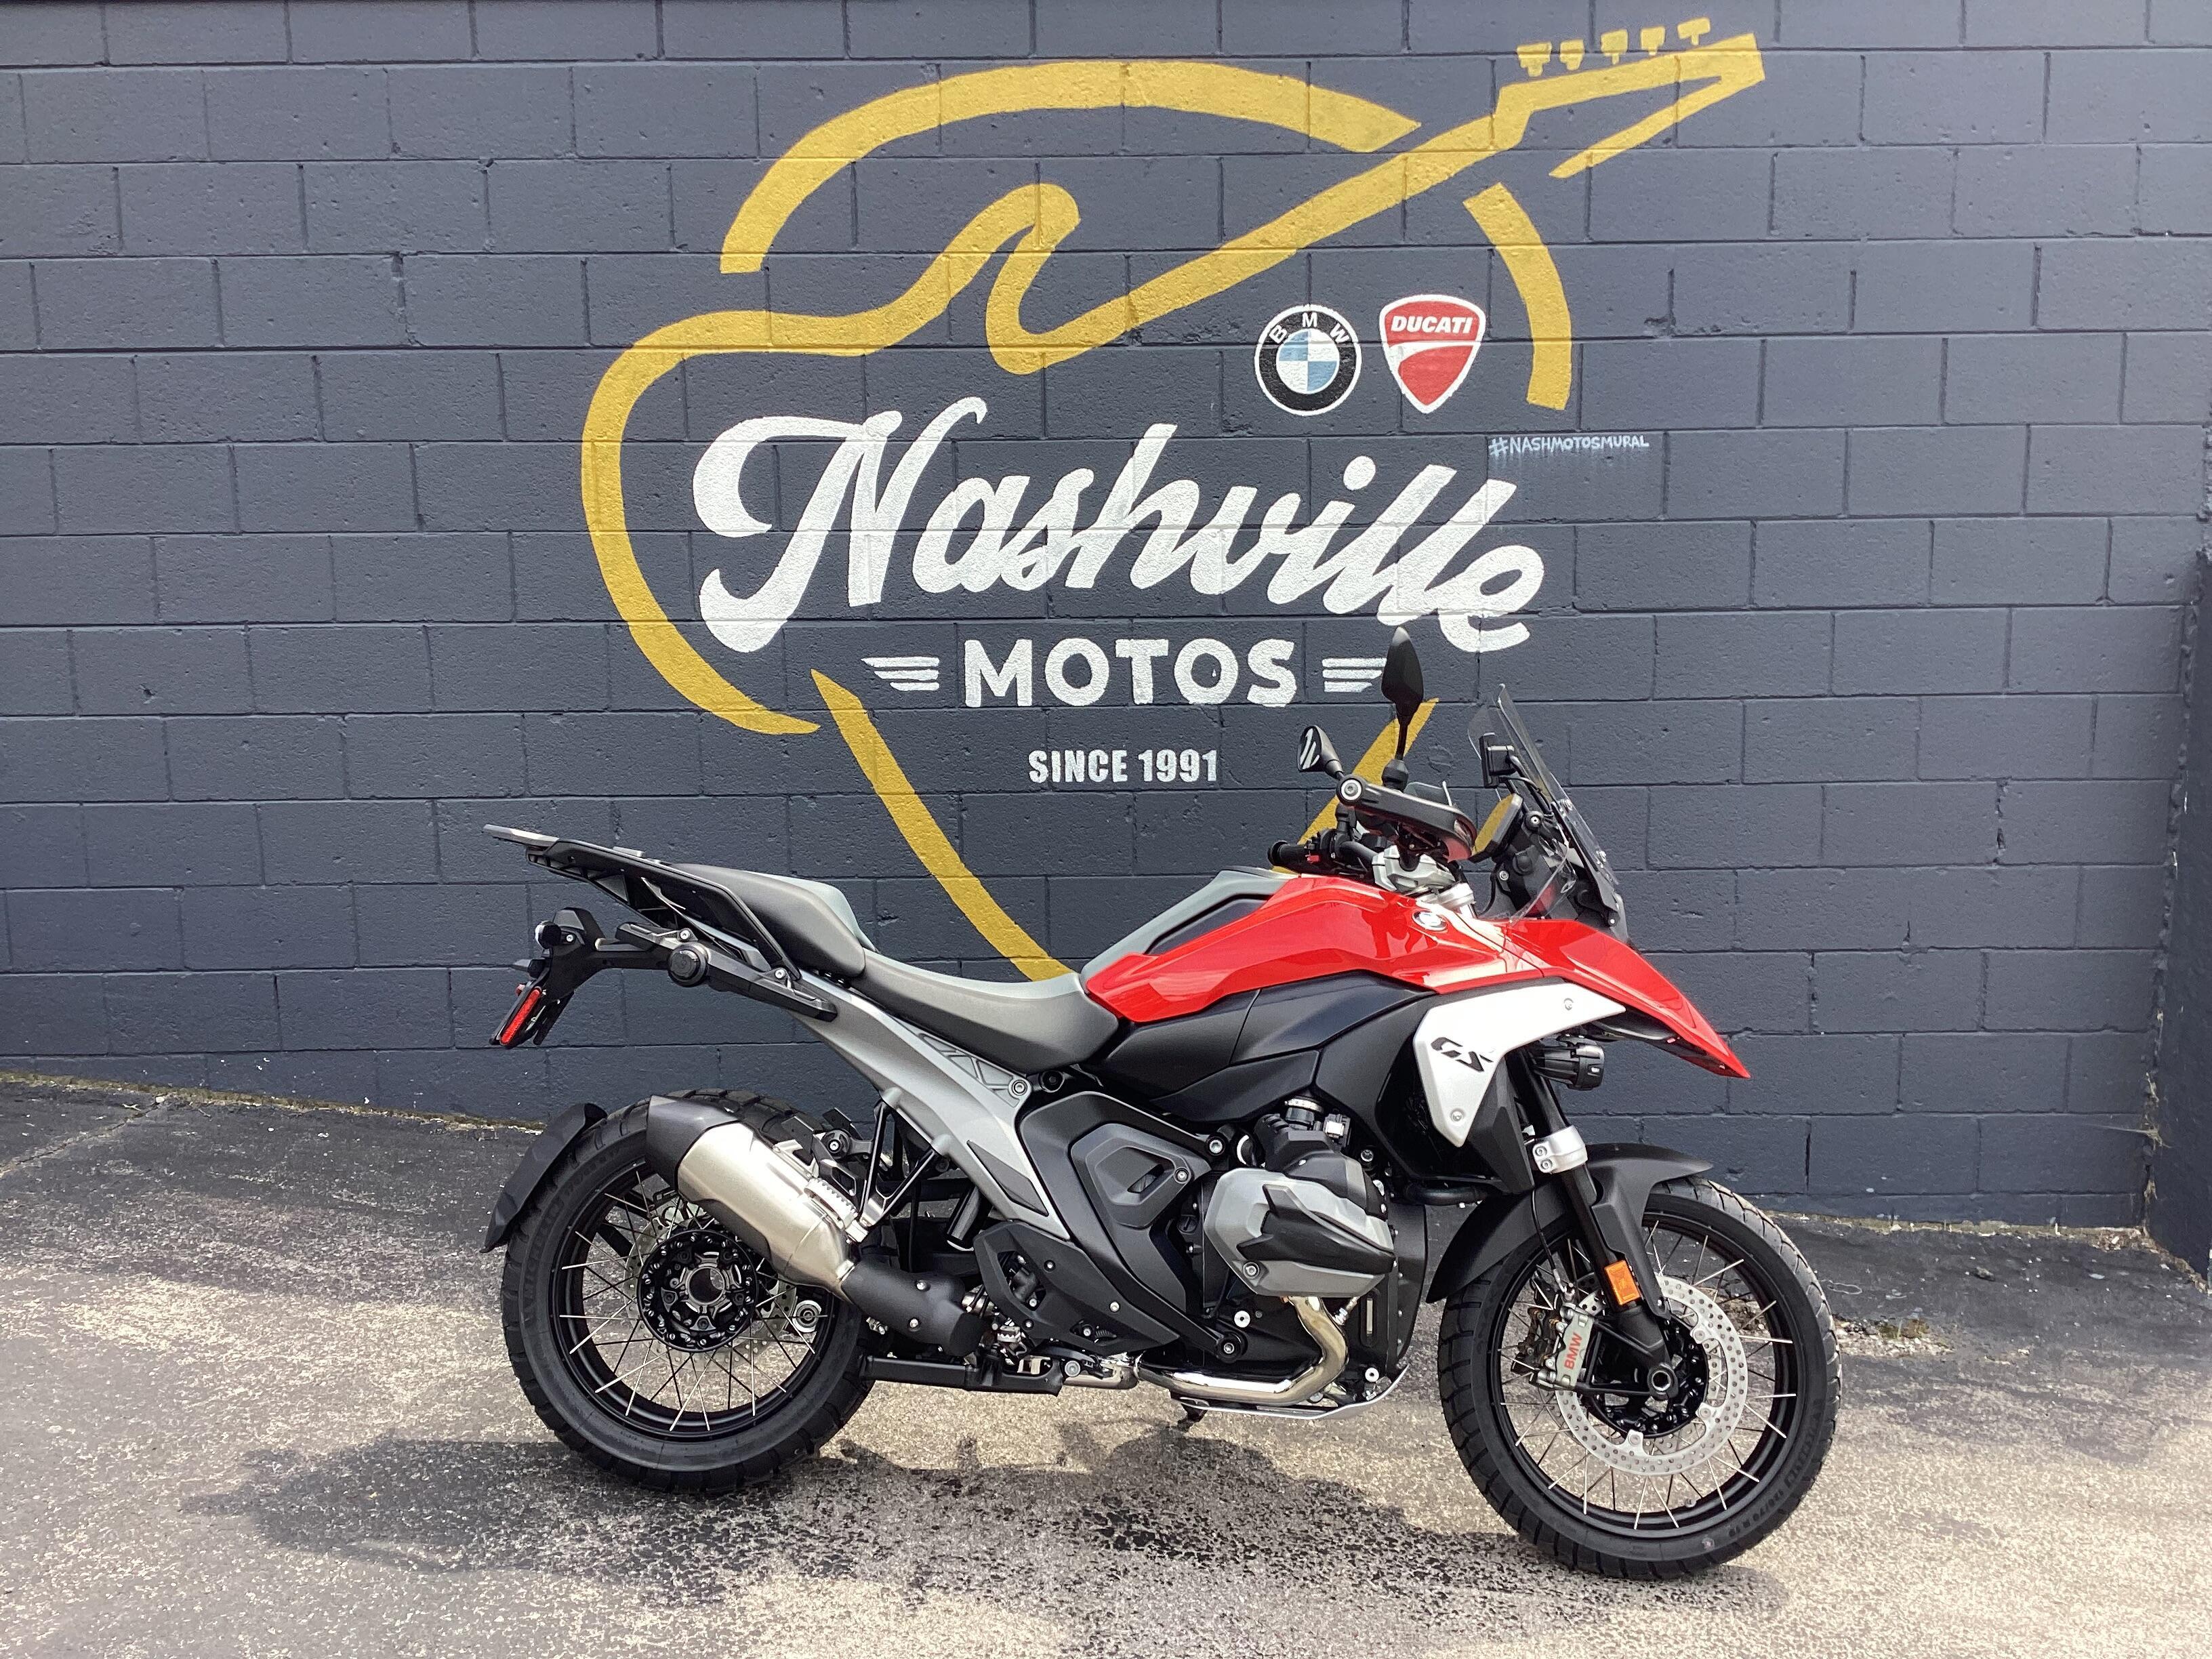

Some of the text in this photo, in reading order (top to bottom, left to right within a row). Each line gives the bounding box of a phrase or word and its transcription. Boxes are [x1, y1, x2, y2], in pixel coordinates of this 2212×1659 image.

[1269, 312, 1348, 344] BMW
[1390, 314, 1474, 334] DUCATI
[1488, 435, 1650, 457] #NASHMOTOSMURAL
[693, 397, 1544, 653] Nashville
[964, 638, 1298, 708] MOTOS
[1028, 749, 1217, 783] SINCE 1991
[1564, 1332, 1582, 1369] BMW
